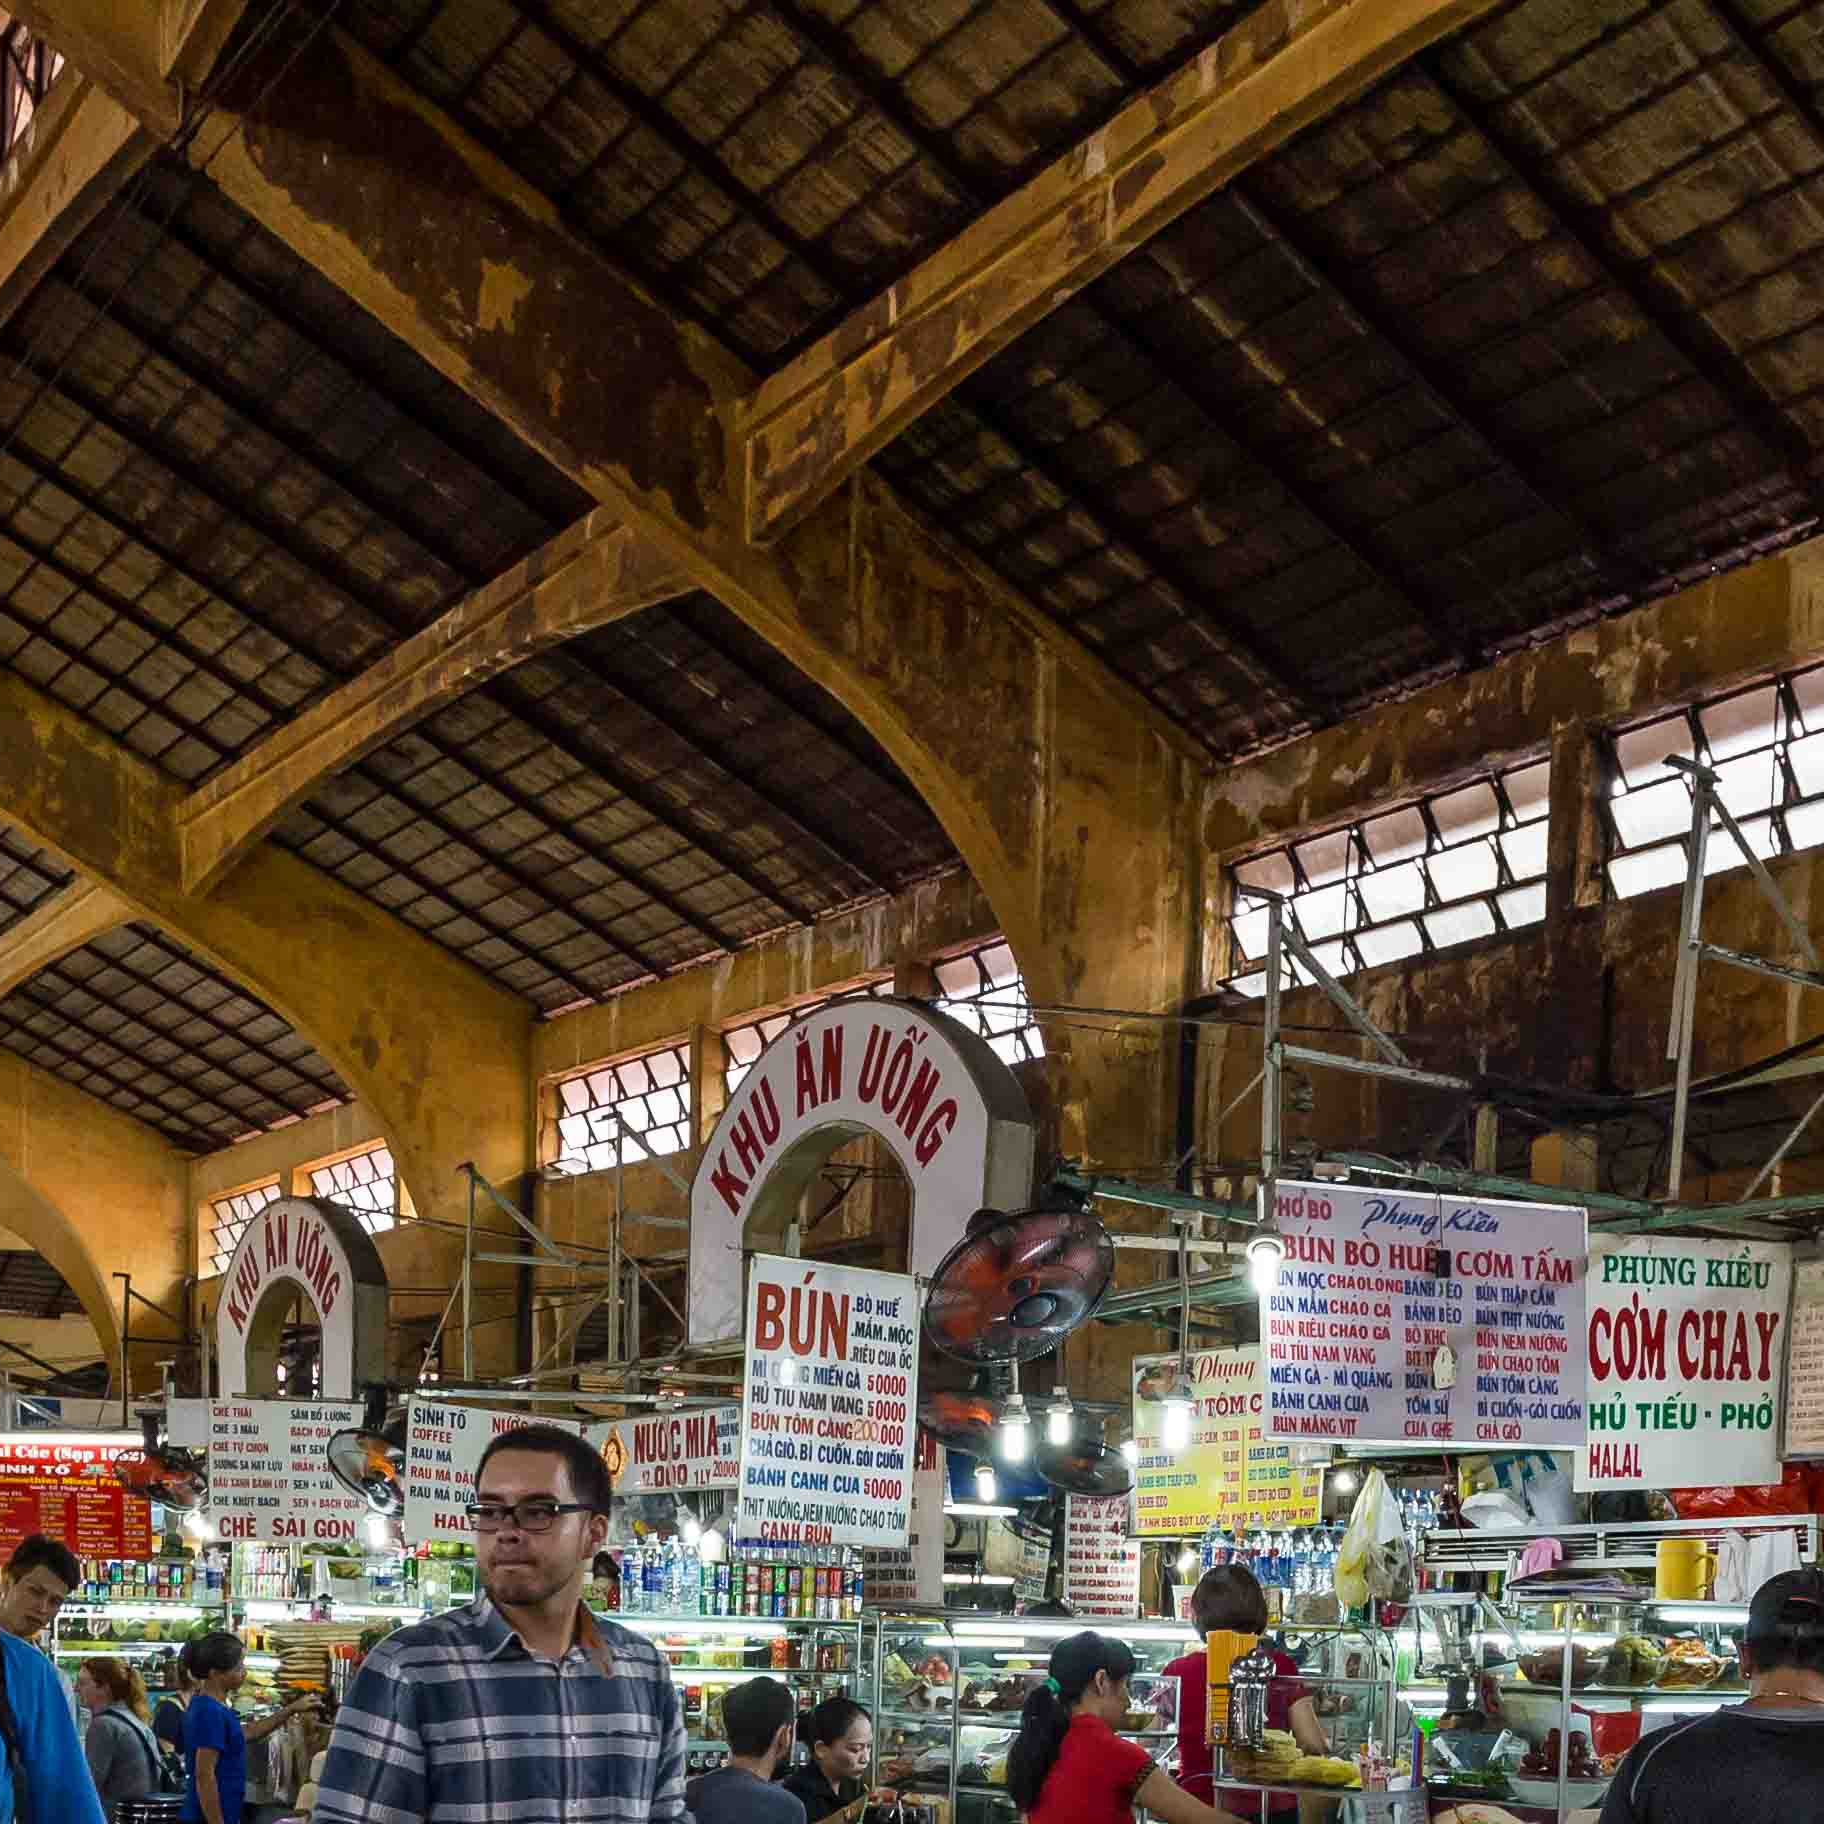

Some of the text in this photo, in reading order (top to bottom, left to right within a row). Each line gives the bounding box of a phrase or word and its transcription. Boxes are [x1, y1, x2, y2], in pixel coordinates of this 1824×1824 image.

[711, 1024, 958, 1217] KHU ĂN UỐNG
[1308, 1193, 1332, 1221] BÒ
[1362, 1199, 1439, 1236] Phụng
[1283, 1227, 1573, 1284] BÚN BÒ CƠM TẤM
[227, 1213, 340, 1336] KHU ĂN UỐNG
[1602, 1246, 1771, 1292] PHỤNG KIỀU
[755, 1271, 850, 1360] BÚN
[877, 1297, 902, 1318] HUẾ
[1502, 1335, 1525, 1350] NEM
[1589, 1292, 1667, 1381] CƠM
[1678, 1308, 1779, 1381] CHAY
[878, 1351, 896, 1369] CUA
[1312, 1345, 1339, 1362] NAM
[845, 1367, 861, 1390] GÀ
[867, 1375, 906, 1396] 50000
[1305, 1363, 1321, 1385] GÀ
[799, 1392, 826, 1411] NAM
[867, 1400, 906, 1423] 50000
[1272, 1388, 1304, 1409] BÁNH
[1309, 1393, 1341, 1411] CANH
[1345, 1396, 1369, 1412] CUA
[1589, 1392, 1773, 1430] HỦ TIẾU PHỞ
[414, 1407, 468, 1430] SINH TỐ
[751, 1408, 813, 1435] BÚN TÔM
[1274, 1412, 1296, 1433] BÚN
[1404, 1423, 1428, 1438] CUA
[412, 1428, 452, 1443] COFFEE
[309, 1444, 325, 1455] SEN
[412, 1446, 432, 1460] RAU
[1589, 1444, 1643, 1478] HALAL
[42, 1462, 71, 1475] TỐ
[410, 1465, 432, 1479] RAU
[293, 1479, 309, 1490] SEN
[410, 1485, 431, 1500] RAU
[747, 1465, 902, 1500] BÁNH CANH CUA 50000
[219, 1512, 355, 1539] CHÈ SÀI GÒN
